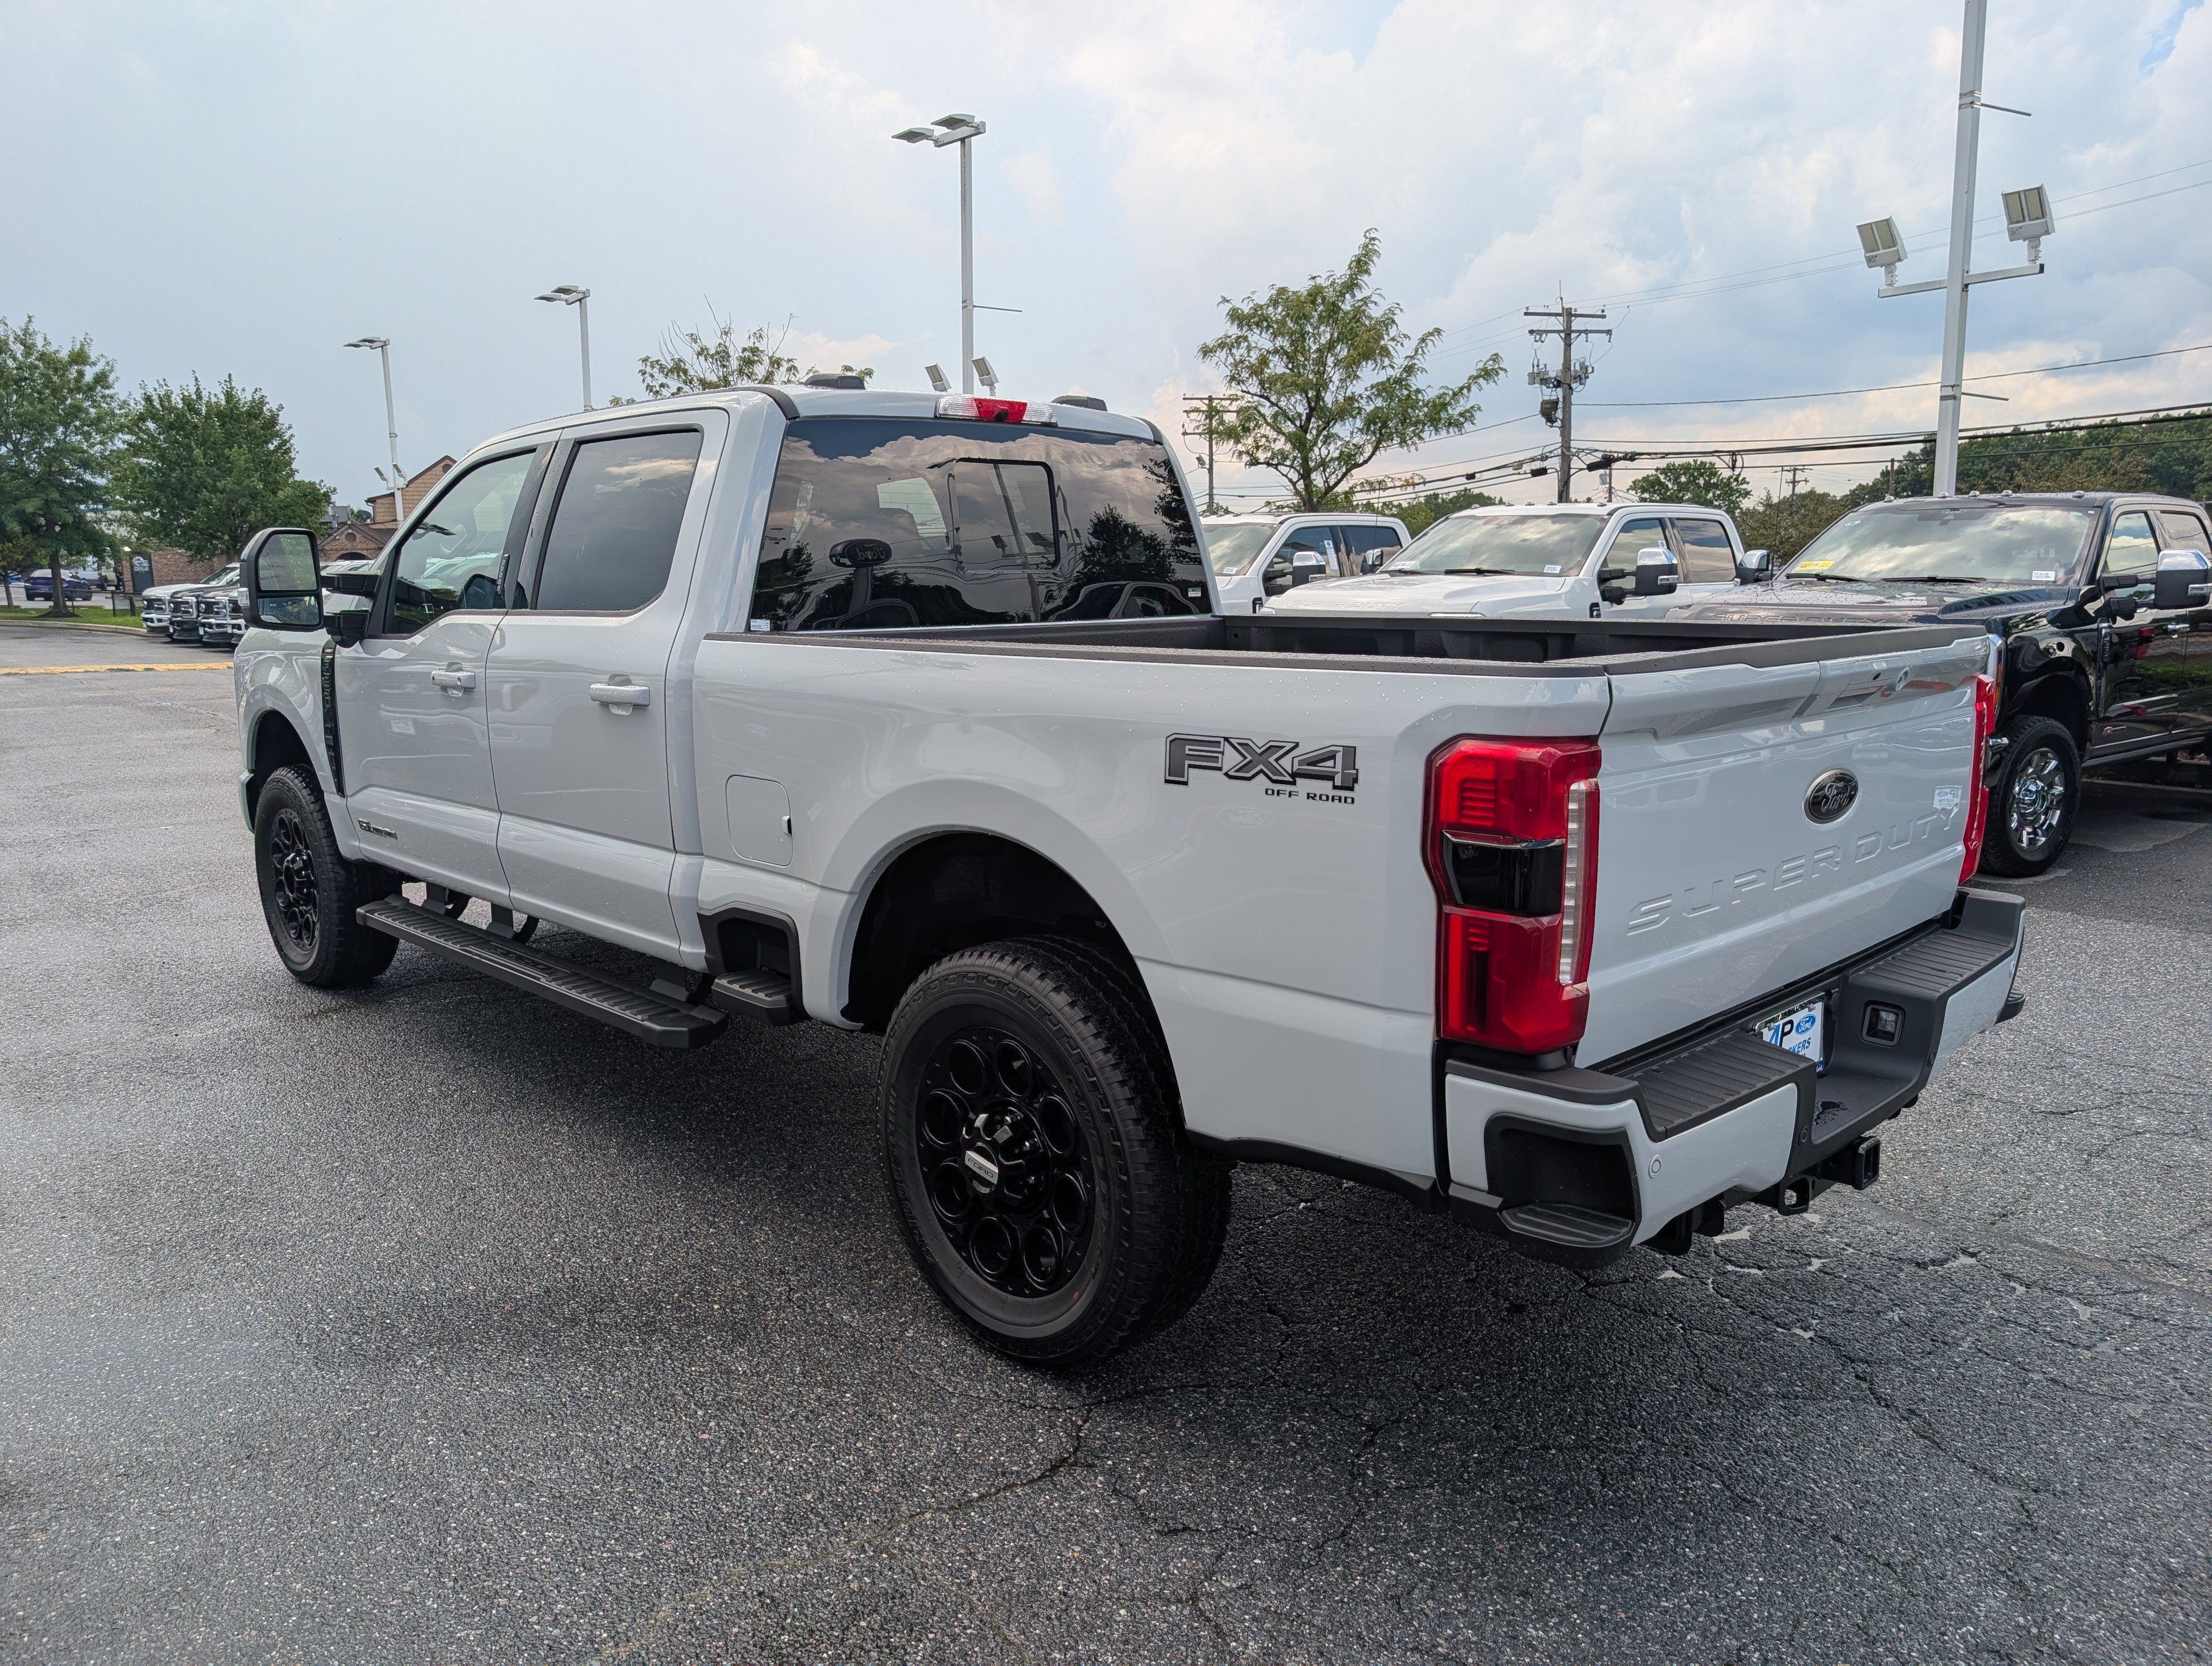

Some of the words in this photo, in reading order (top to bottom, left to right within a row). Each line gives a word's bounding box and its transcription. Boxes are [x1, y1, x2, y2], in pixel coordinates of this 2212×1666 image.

[1290, 600, 1347, 608] SUPER
[1352, 601, 1405, 610] DUTY
[1709, 614, 1799, 623] SUPER
[1164, 732, 1359, 791] FX4
[1265, 788, 1300, 798] OFF
[1307, 792, 1355, 804] ROAD
[1821, 781, 1856, 812] Ford
[1627, 845, 1841, 935] SUPER
[1855, 803, 1959, 863] DUTY
[1798, 1018, 1812, 1033] Ford
[967, 1158, 994, 1178] FORD
